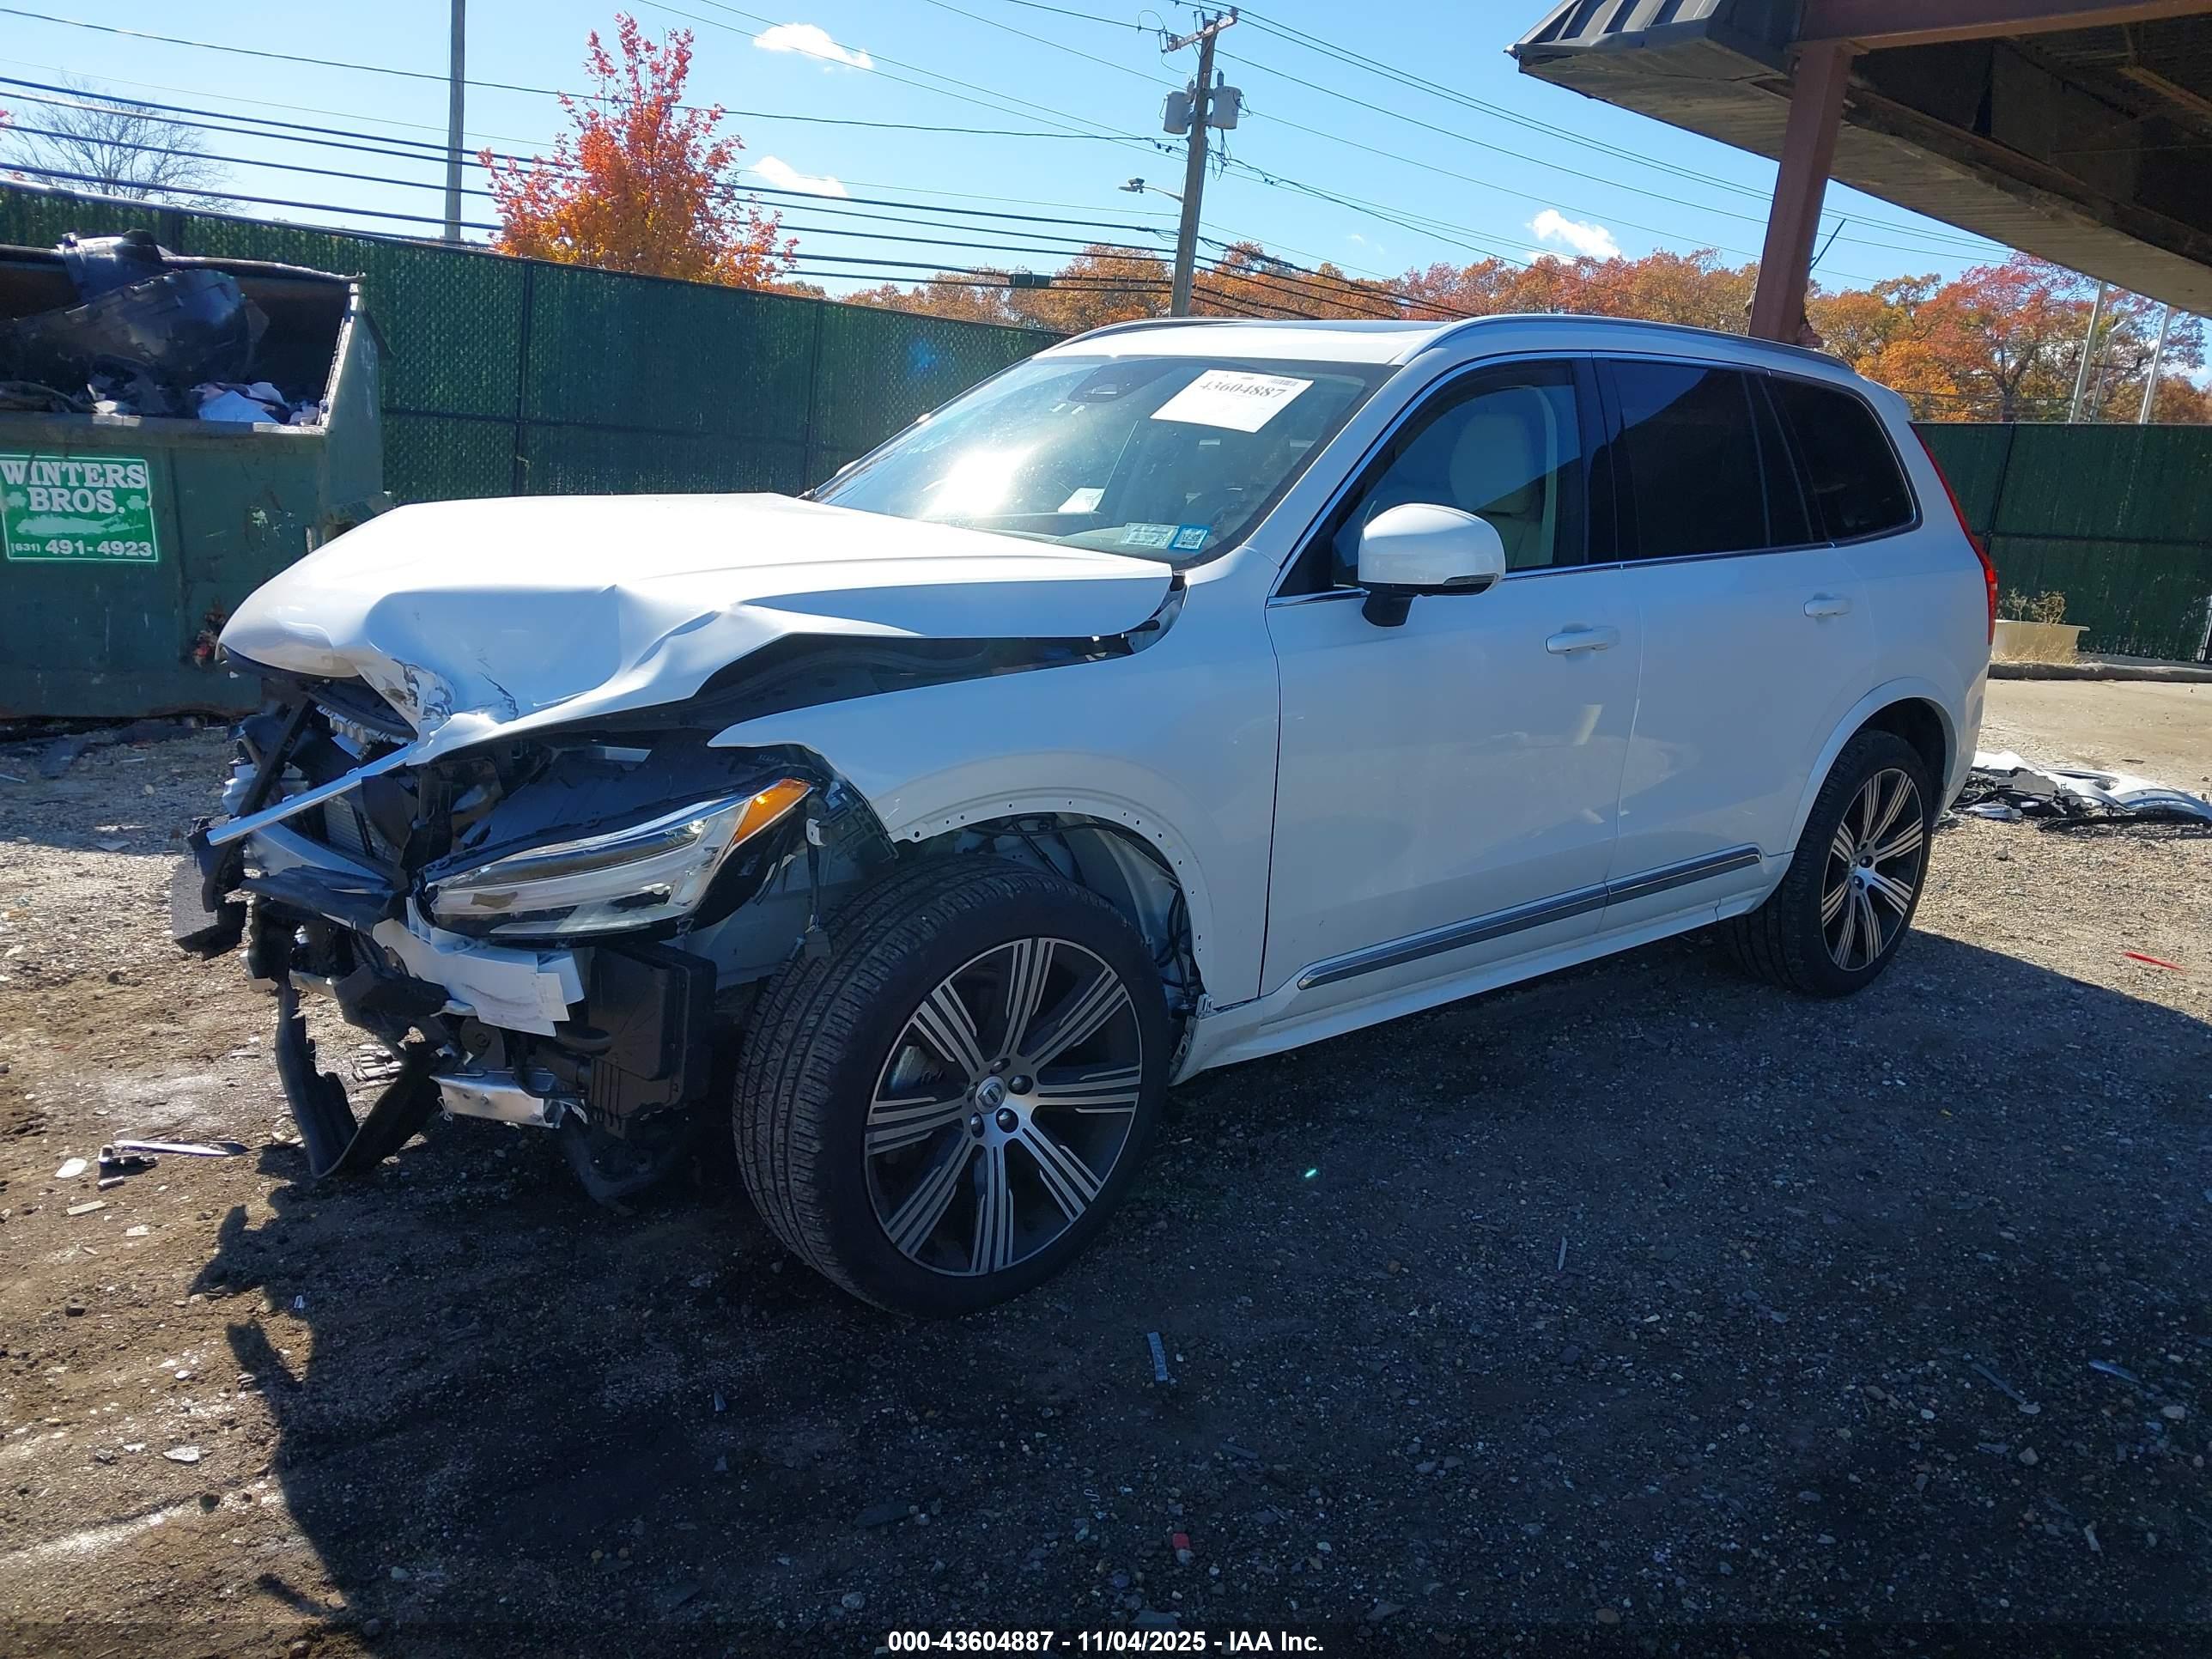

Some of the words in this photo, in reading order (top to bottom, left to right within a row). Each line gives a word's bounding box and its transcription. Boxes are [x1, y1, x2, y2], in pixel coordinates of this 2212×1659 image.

[1200, 380, 1287, 398] 43604887
[0, 460, 147, 489] WINTERS
[27, 487, 125, 514] BROS.
[10, 543, 41, 555] (631)
[45, 539, 152, 557] 491-4923
